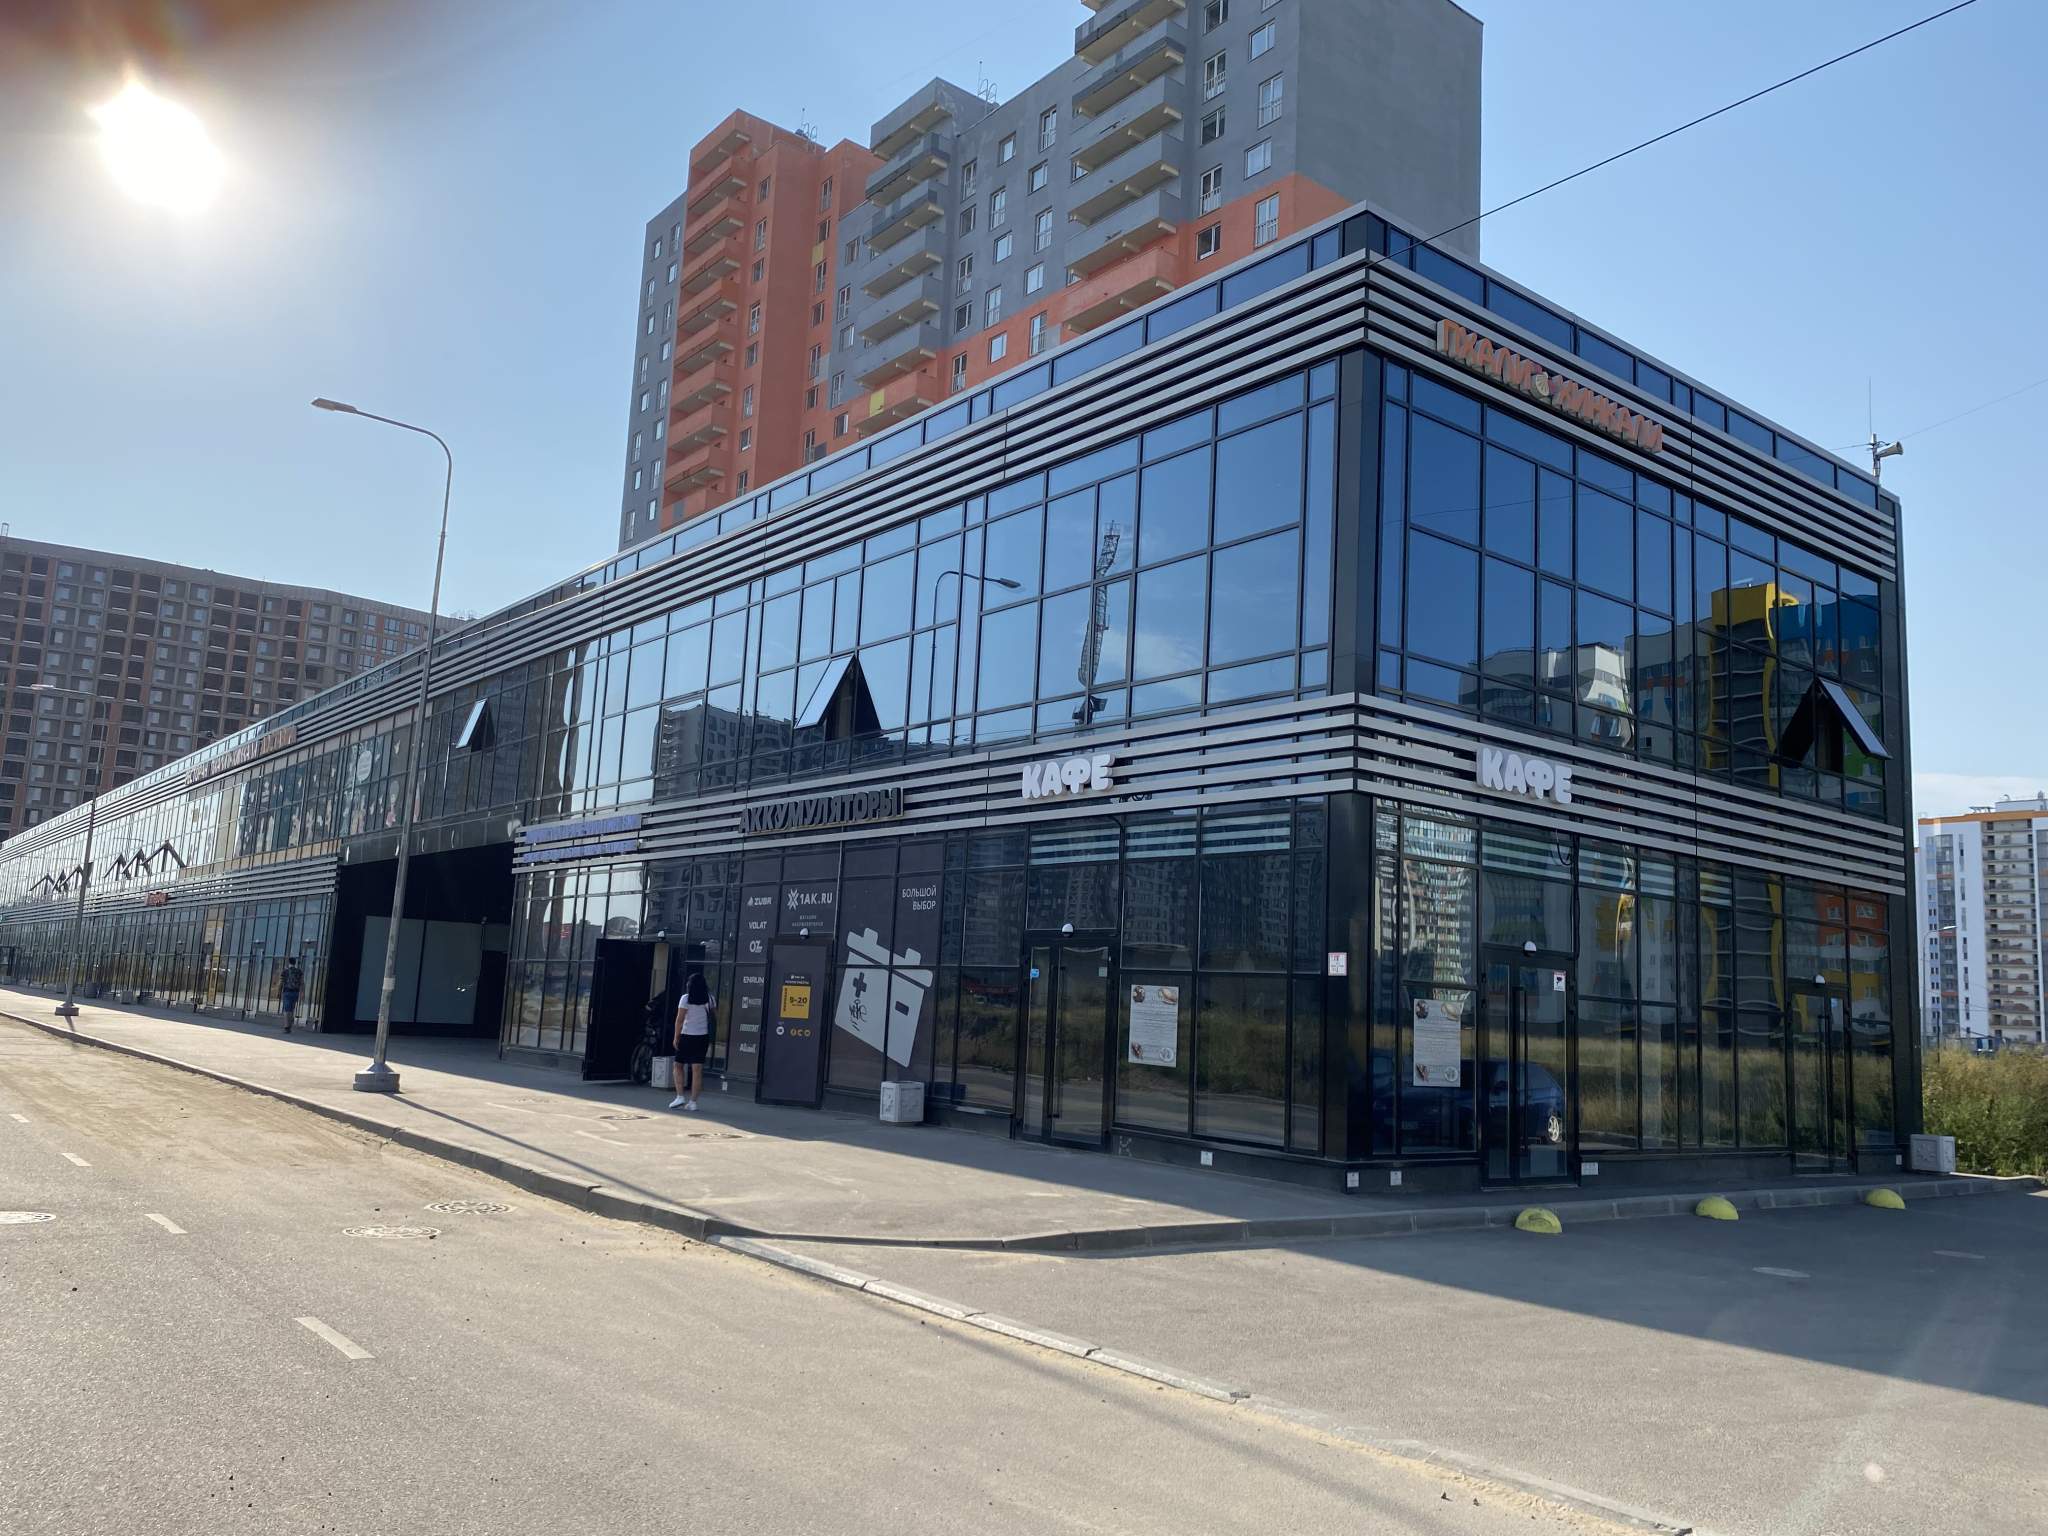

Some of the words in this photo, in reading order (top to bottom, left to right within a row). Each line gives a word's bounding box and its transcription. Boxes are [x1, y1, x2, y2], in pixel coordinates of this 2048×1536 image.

[1021, 753, 1114, 799] КАФЕ
[1477, 746, 1573, 804] КАФЕ
[738, 787, 903, 834] АККУМУЛЯТОРЫ
[902, 884, 937, 898] БОЛЬШОЙ
[799, 892, 833, 905] 1AK.RU
[912, 900, 937, 911] ВЫБОР
[748, 921, 767, 930] VOLAT
